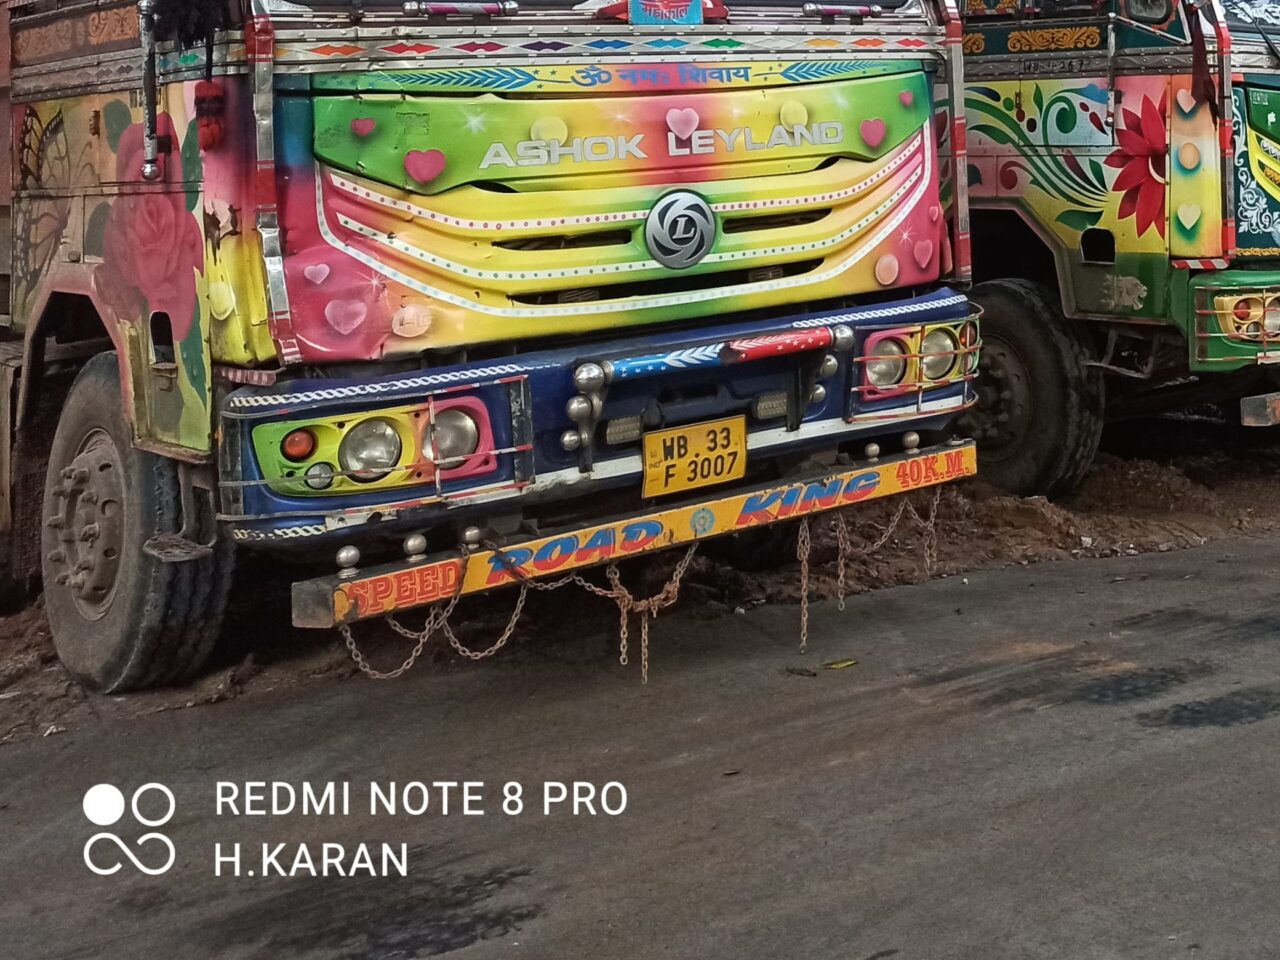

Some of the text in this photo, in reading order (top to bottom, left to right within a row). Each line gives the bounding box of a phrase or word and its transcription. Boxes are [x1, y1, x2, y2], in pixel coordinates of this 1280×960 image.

[679, 64, 752, 84] शिवाय
[478, 120, 845, 169] ASHOK LEYLAND
[662, 427, 731, 461] WB 33
[664, 451, 738, 488] F 3007
[350, 560, 460, 613] SPEED
[485, 520, 664, 585] ROAD
[735, 471, 881, 526] KING
